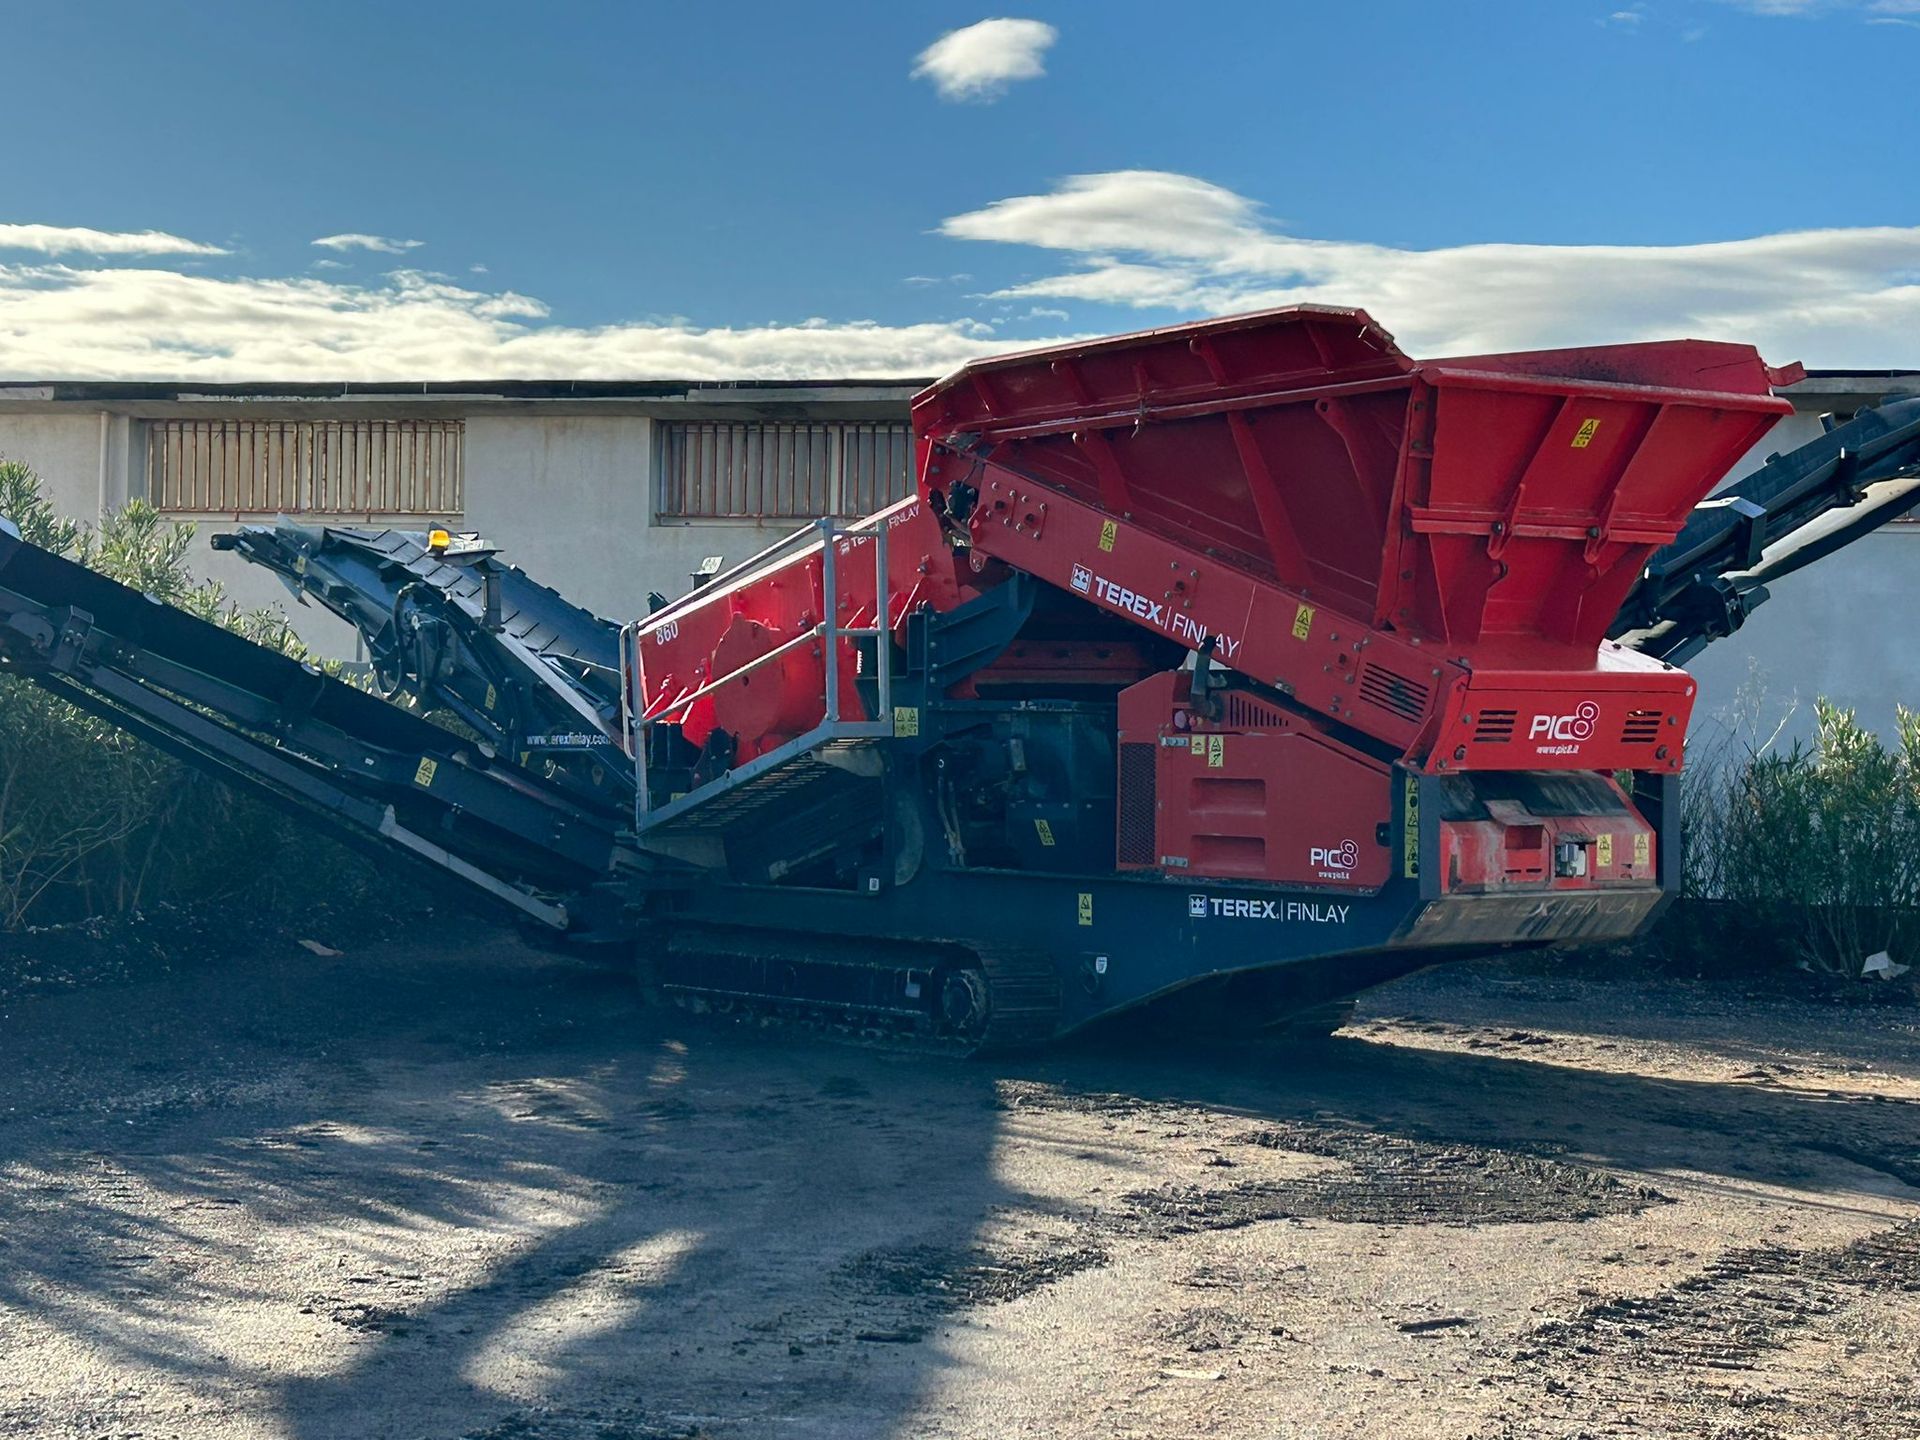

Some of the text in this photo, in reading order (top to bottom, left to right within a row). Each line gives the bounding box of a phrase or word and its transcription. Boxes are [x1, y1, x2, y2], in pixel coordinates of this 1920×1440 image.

[1096, 576, 1163, 625] TEREX
[656, 620, 679, 646] 860
[1528, 701, 1600, 741] PIC8
[1310, 839, 1359, 869] PIC8
[1210, 898, 1350, 923] TEREX FINLAY
